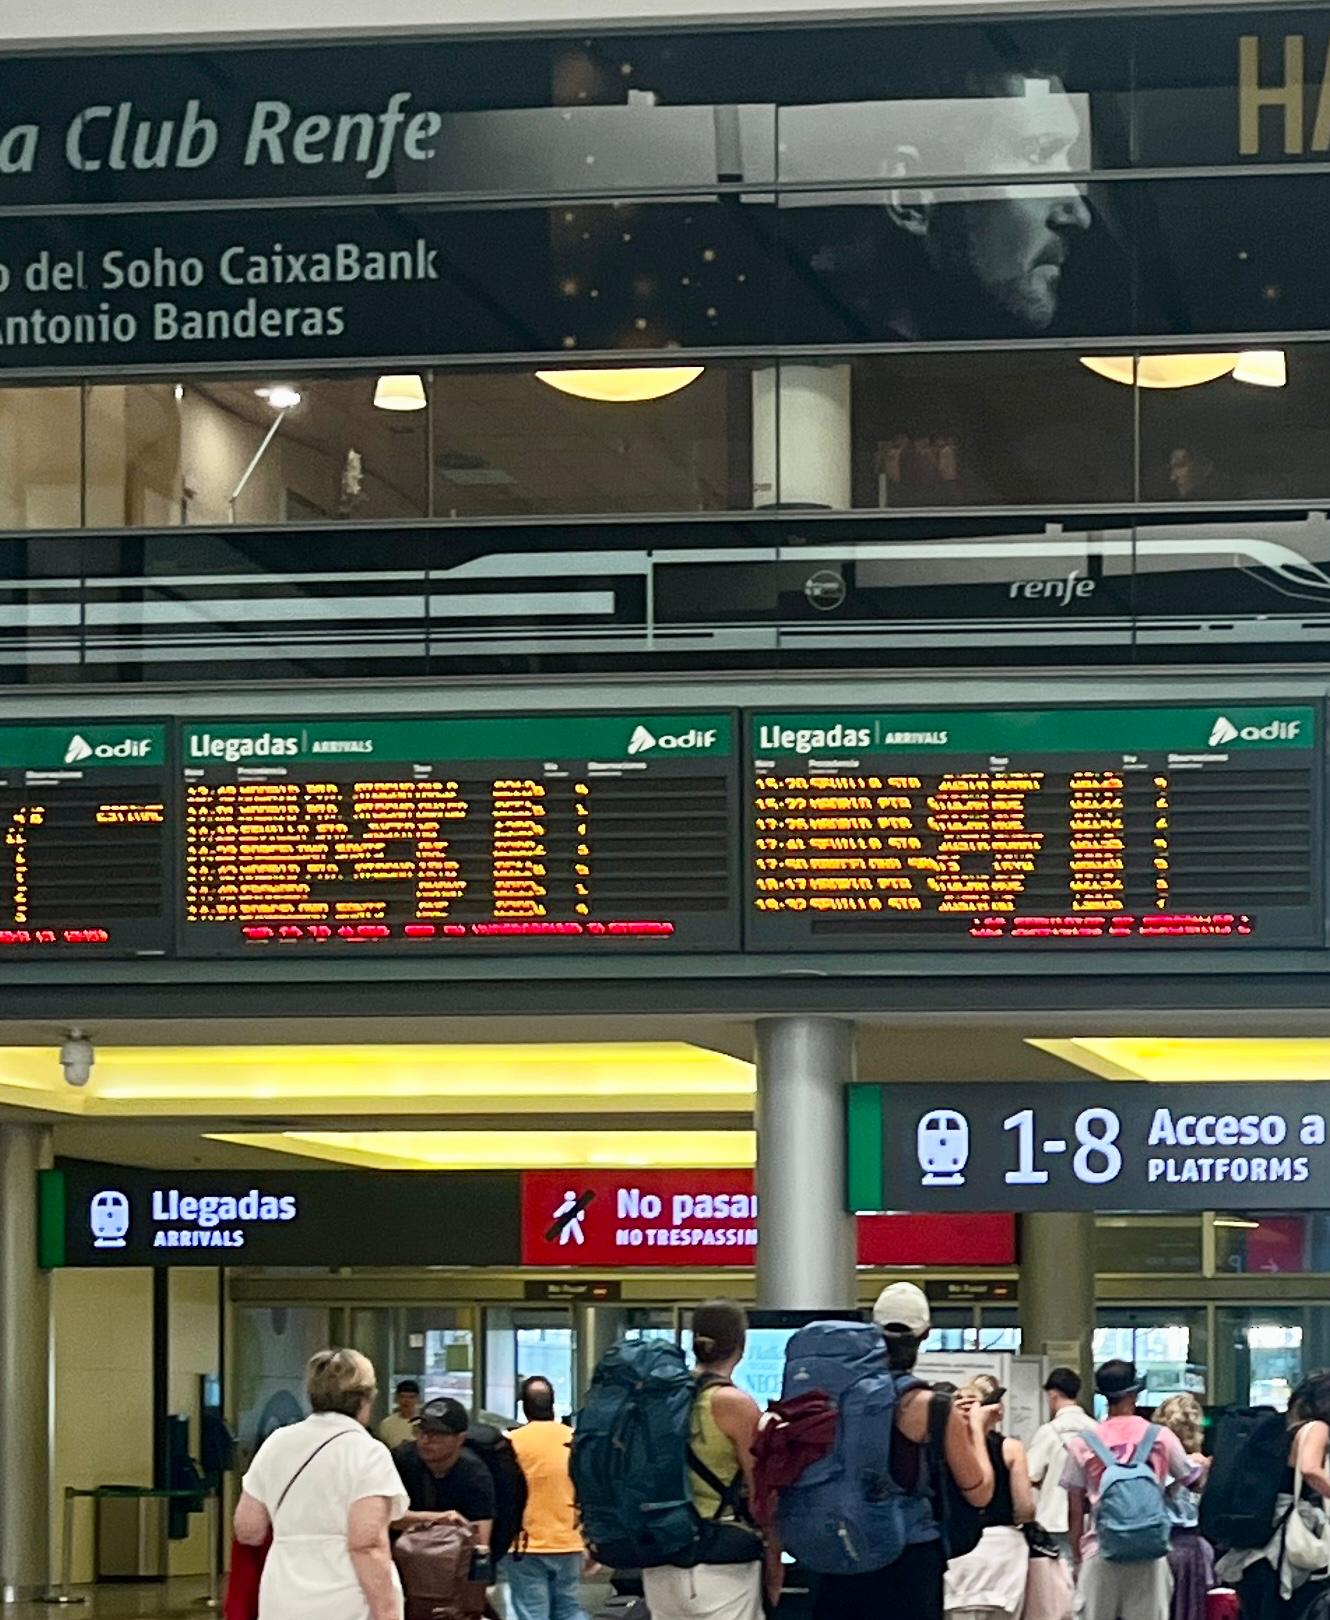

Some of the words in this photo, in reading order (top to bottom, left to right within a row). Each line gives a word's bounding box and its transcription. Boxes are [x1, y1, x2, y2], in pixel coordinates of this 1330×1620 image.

[66, 100, 218, 171] Club
[245, 92, 442, 178] Renfe
[26, 250, 88, 292] del
[103, 247, 204, 289] Soho
[220, 239, 438, 285] CaixaBank
[0, 302, 137, 345] ntonio
[154, 297, 344, 341] Banderas
[1009, 569, 1096, 607] renfe
[657, 729, 717, 749] adif
[760, 724, 871, 754] Llegadas
[884, 731, 948, 745] ARRIVALS
[1239, 720, 1301, 741] adif
[94, 738, 152, 758] adif
[190, 732, 299, 762] Llegadas
[312, 738, 374, 754] ARRIVALS
[1147, 1108, 1287, 1146] Acceso
[1300, 1114, 1326, 1145] a
[1003, 1107, 1122, 1184] 1-8
[1148, 1157, 1309, 1183] PLATFORMS
[153, 1189, 297, 1227] Llegadas
[617, 1188, 662, 1219] No
[153, 1230, 244, 1247] ARRIVALS
[616, 1229, 643, 1246] NO
[645, 1229, 758, 1246] TRESPASSIN
